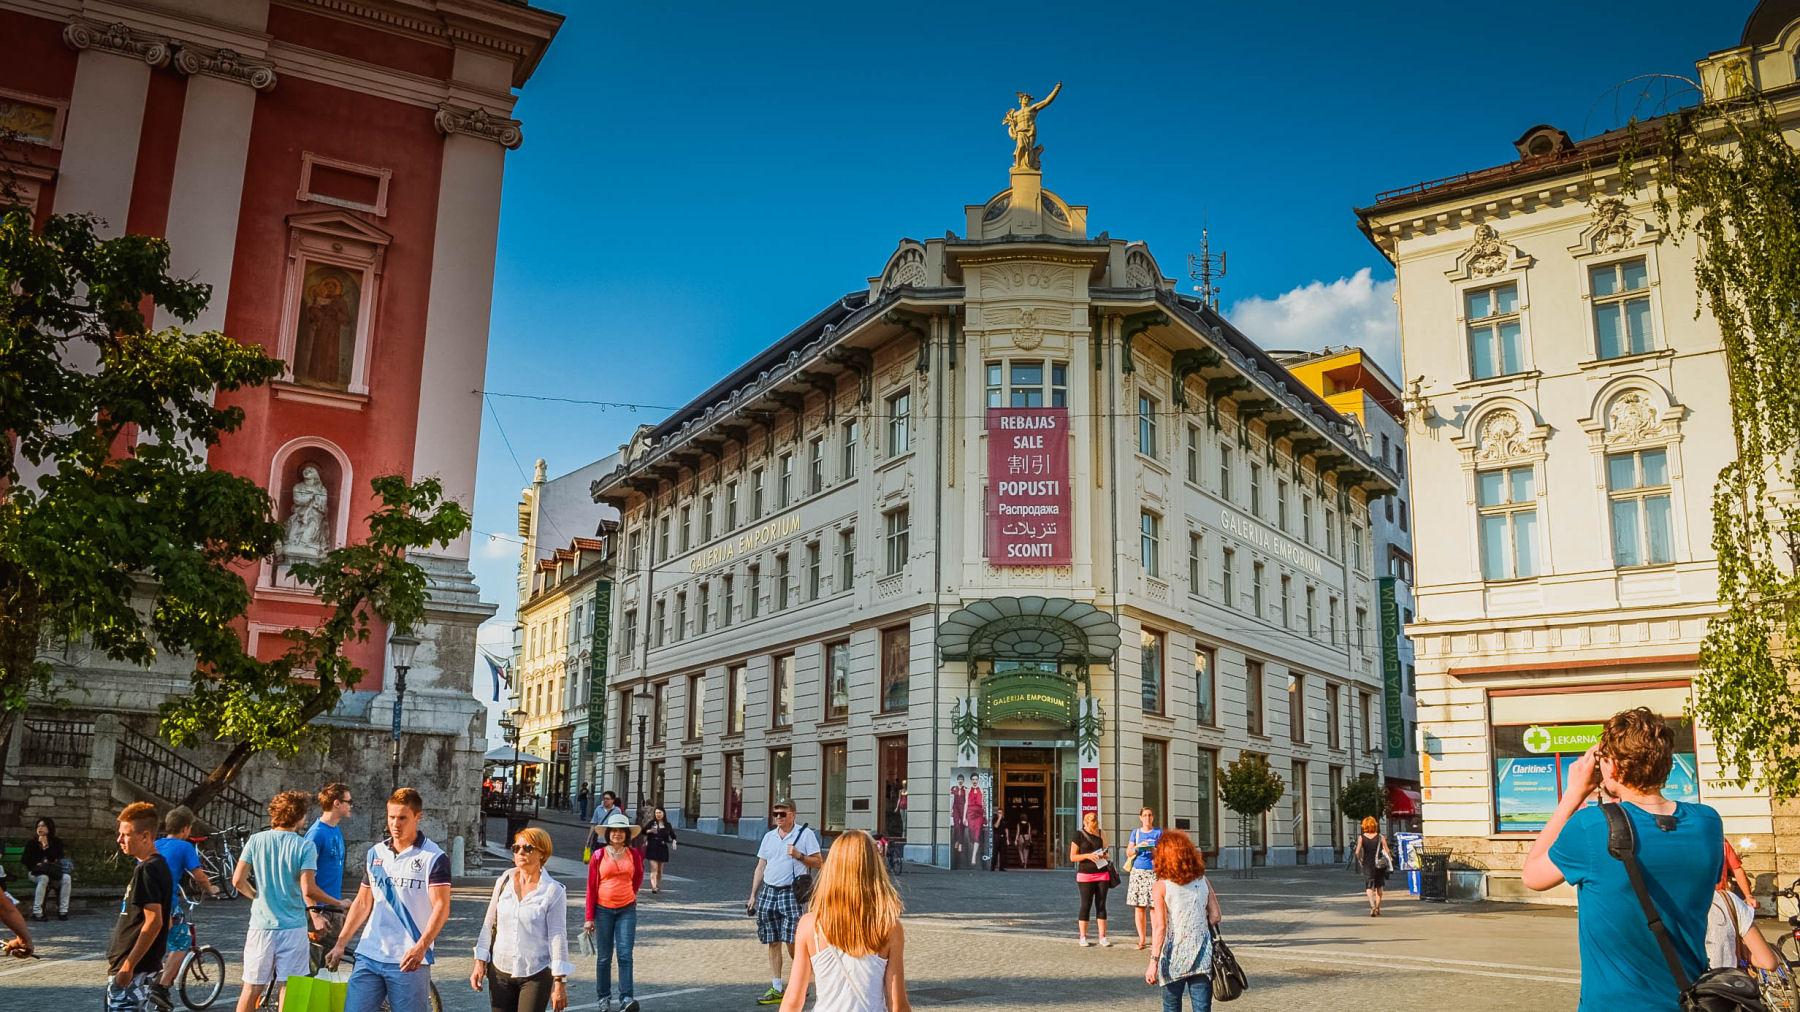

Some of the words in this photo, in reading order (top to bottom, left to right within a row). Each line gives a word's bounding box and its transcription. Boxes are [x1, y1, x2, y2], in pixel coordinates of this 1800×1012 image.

[1001, 416, 1056, 430] REBAJAS
[1013, 435, 1044, 449] SALE
[1007, 454, 1050, 475] 割引
[999, 481, 1059, 496] POPUSTI
[999, 503, 1059, 516] Распродажа
[1002, 521, 1057, 539] تنزيلات
[689, 545, 734, 574] GALERIJA
[739, 514, 801, 554] EMPORIUM
[1007, 543, 1053, 557] SCONTI
[1220, 510, 1270, 552] GALERIJA
[1273, 537, 1322, 575] EMPORIUM
[594, 590, 609, 670] EMPORIUM
[1383, 586, 1398, 672] EMPORIUM
[993, 694, 1025, 706] GALERIJA
[1026, 694, 1065, 707] EMPORIUM
[590, 675, 604, 743] GALERIJA
[1387, 678, 1402, 749] GALERIJA
[1553, 735, 1598, 745] LEKARNA
[1512, 764, 1546, 774] Claritine
[370, 877, 426, 889] HACKETT
